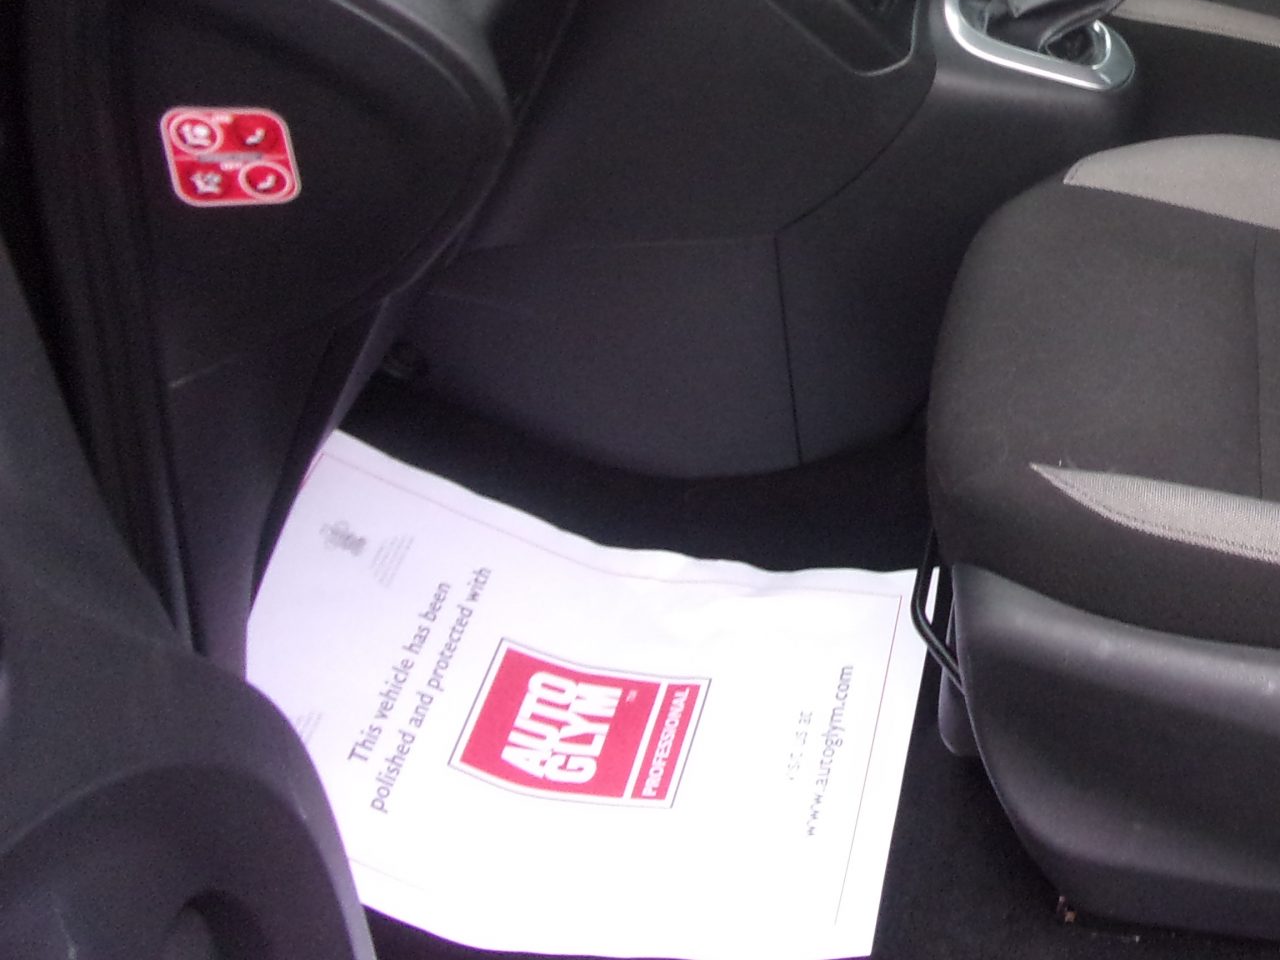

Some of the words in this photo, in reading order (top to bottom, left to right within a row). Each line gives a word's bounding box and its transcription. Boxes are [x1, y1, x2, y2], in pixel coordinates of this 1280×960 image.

[347, 724, 382, 762] This
[374, 657, 415, 721] vehicle
[402, 625, 431, 655] has
[418, 581, 451, 622] been
[370, 729, 416, 814] polished
[409, 690, 434, 728] and
[427, 604, 473, 692] protected
[465, 567, 492, 603] with
[500, 671, 577, 779] AUTO
[545, 682, 623, 784] GLYM
[641, 687, 691, 798] PROFESSIONAL
[806, 664, 854, 837] www.autoglym.com
